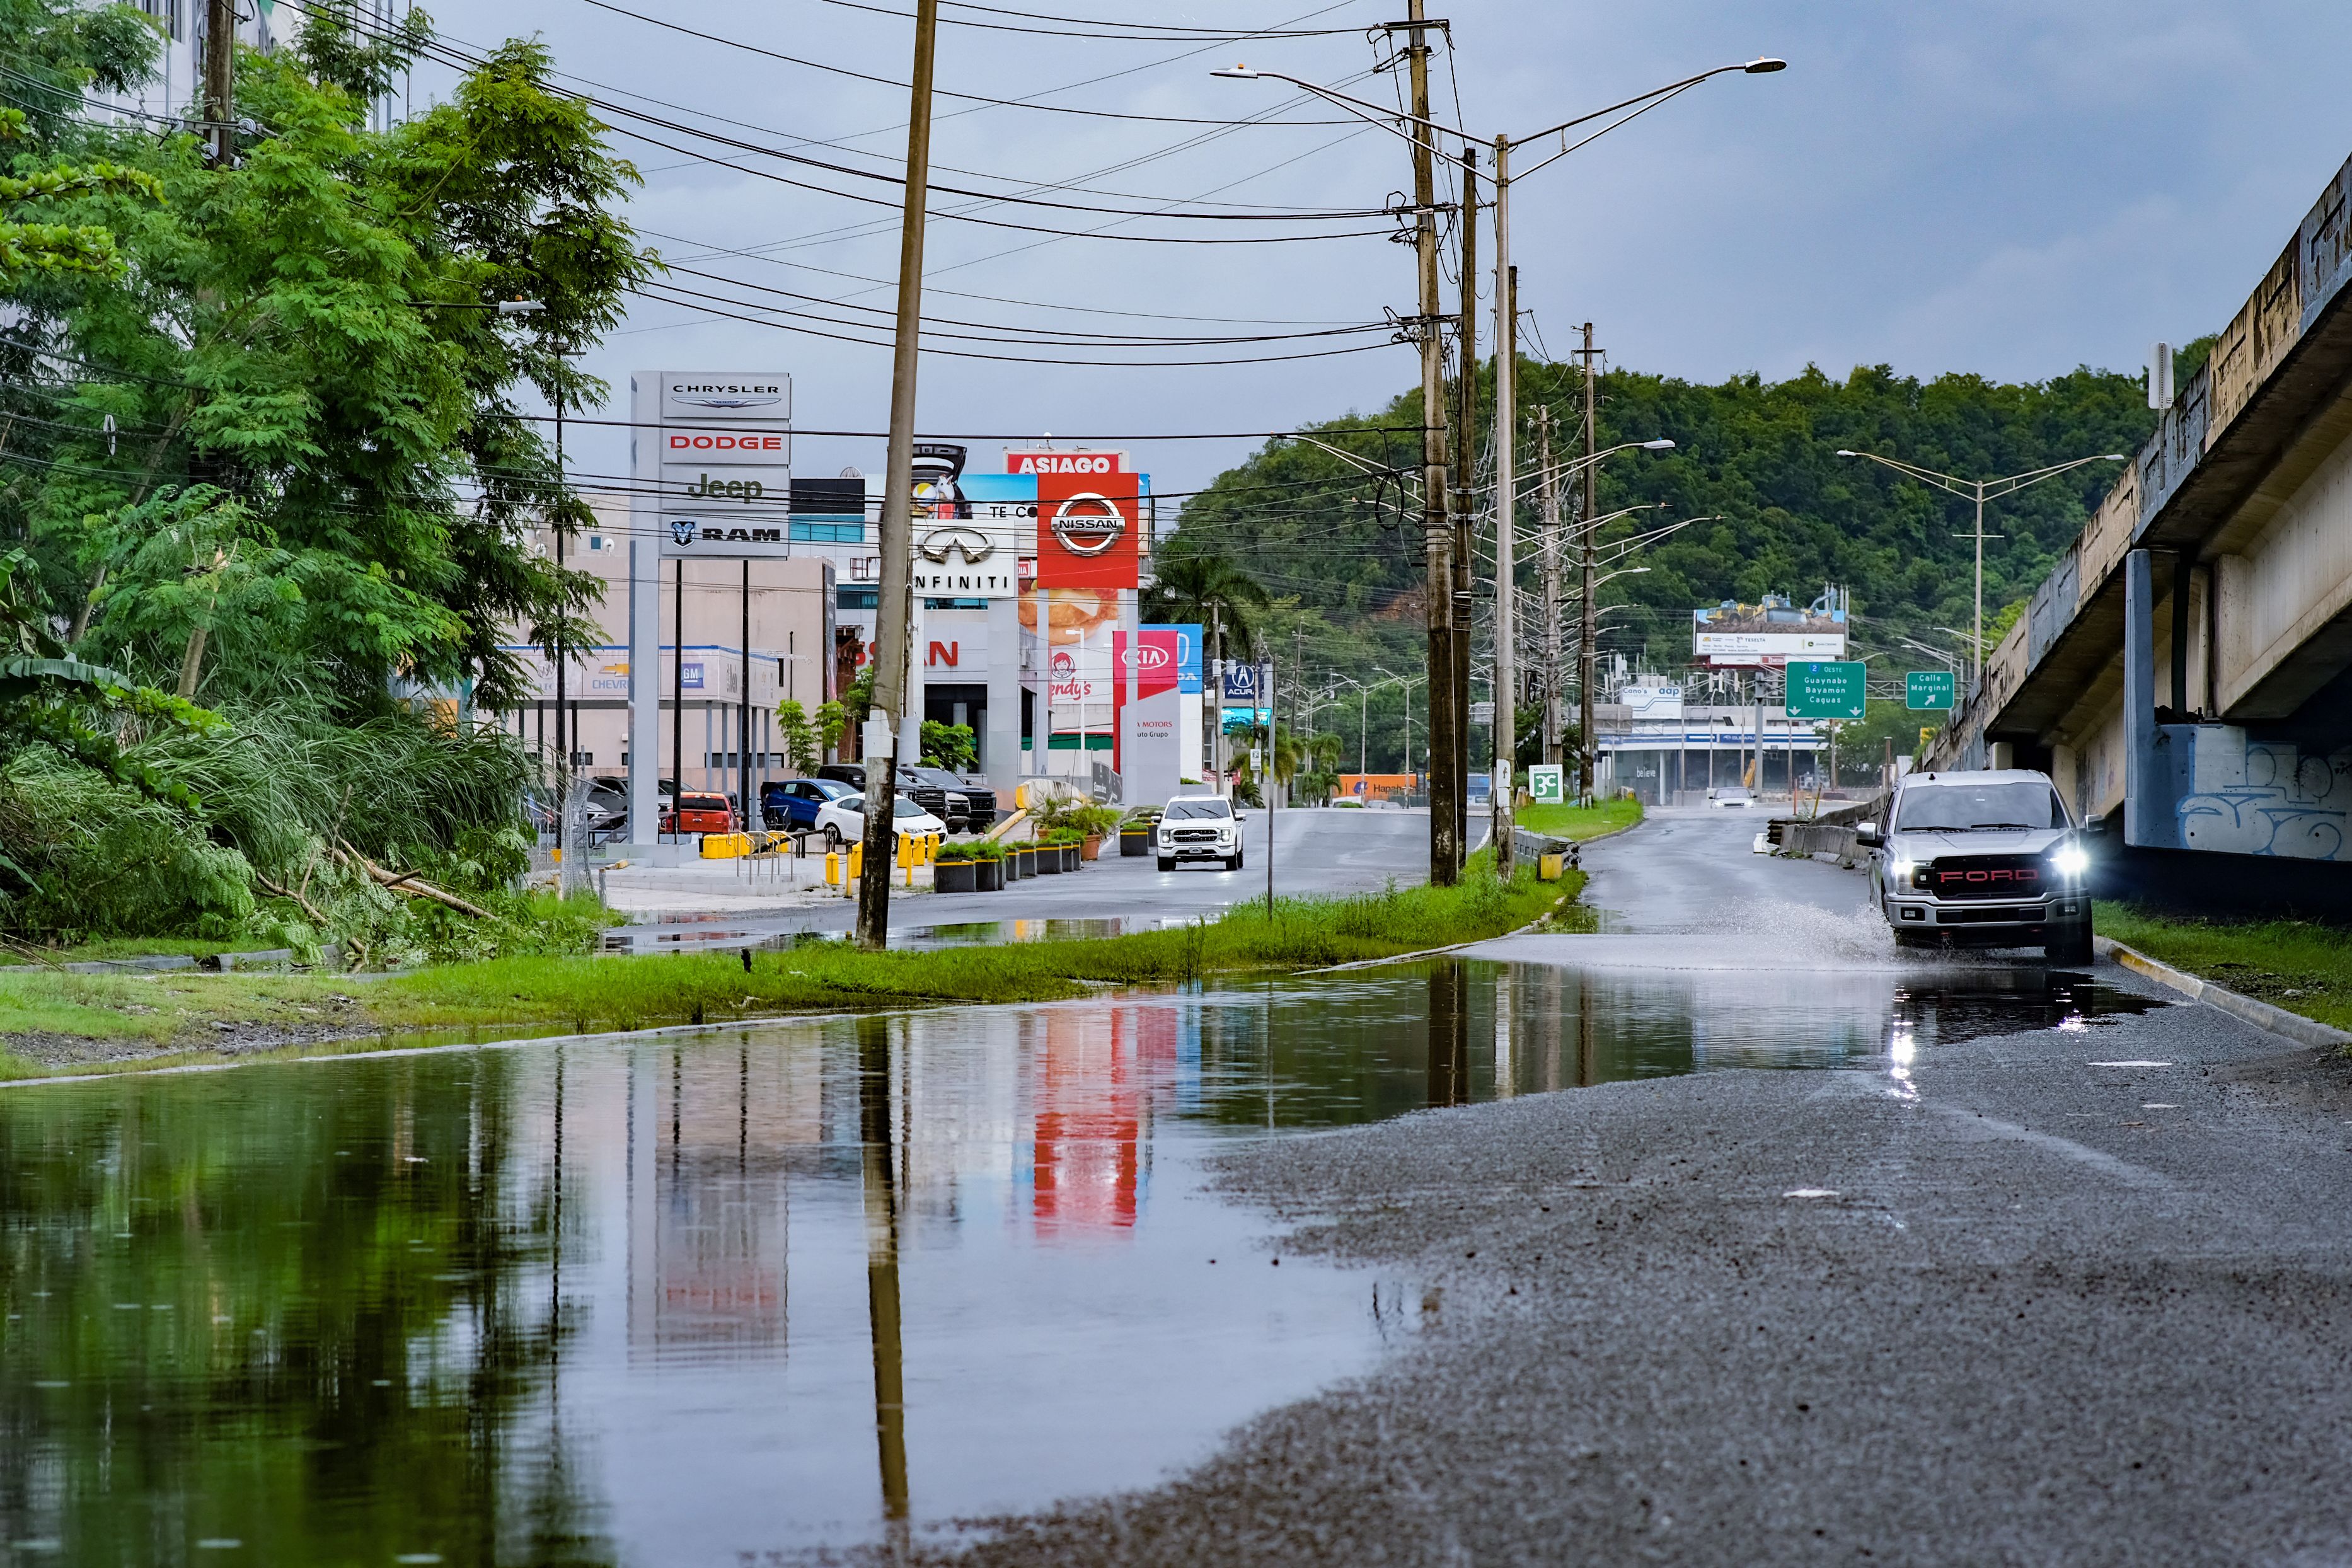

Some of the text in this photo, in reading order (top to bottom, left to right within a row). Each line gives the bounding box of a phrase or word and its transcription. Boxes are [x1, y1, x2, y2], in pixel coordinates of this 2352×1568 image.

[673, 385, 779, 394] CHRYSLER
[670, 435, 781, 450] DODGE
[1018, 457, 1110, 473] ASIAGO
[688, 473, 763, 504] Jeep
[989, 506, 1006, 518] TE
[1059, 519, 1117, 529] NISSAN
[702, 528, 780, 541] RAM
[915, 576, 1007, 589] NFINITI
[683, 668, 698, 679] GM
[592, 680, 628, 689] CHEVR
[1804, 677, 1847, 685] Guaynabo
[1051, 677, 1092, 701] endy's
[1659, 688, 1680, 696] aap
[1806, 686, 1846, 695] Bayamón
[1911, 684, 1949, 693] Marginal
[1809, 696, 1842, 705] Caguas
[1150, 731, 1168, 739] Grupo
[1636, 766, 1656, 778] believe
[1940, 869, 2039, 882] FORD
